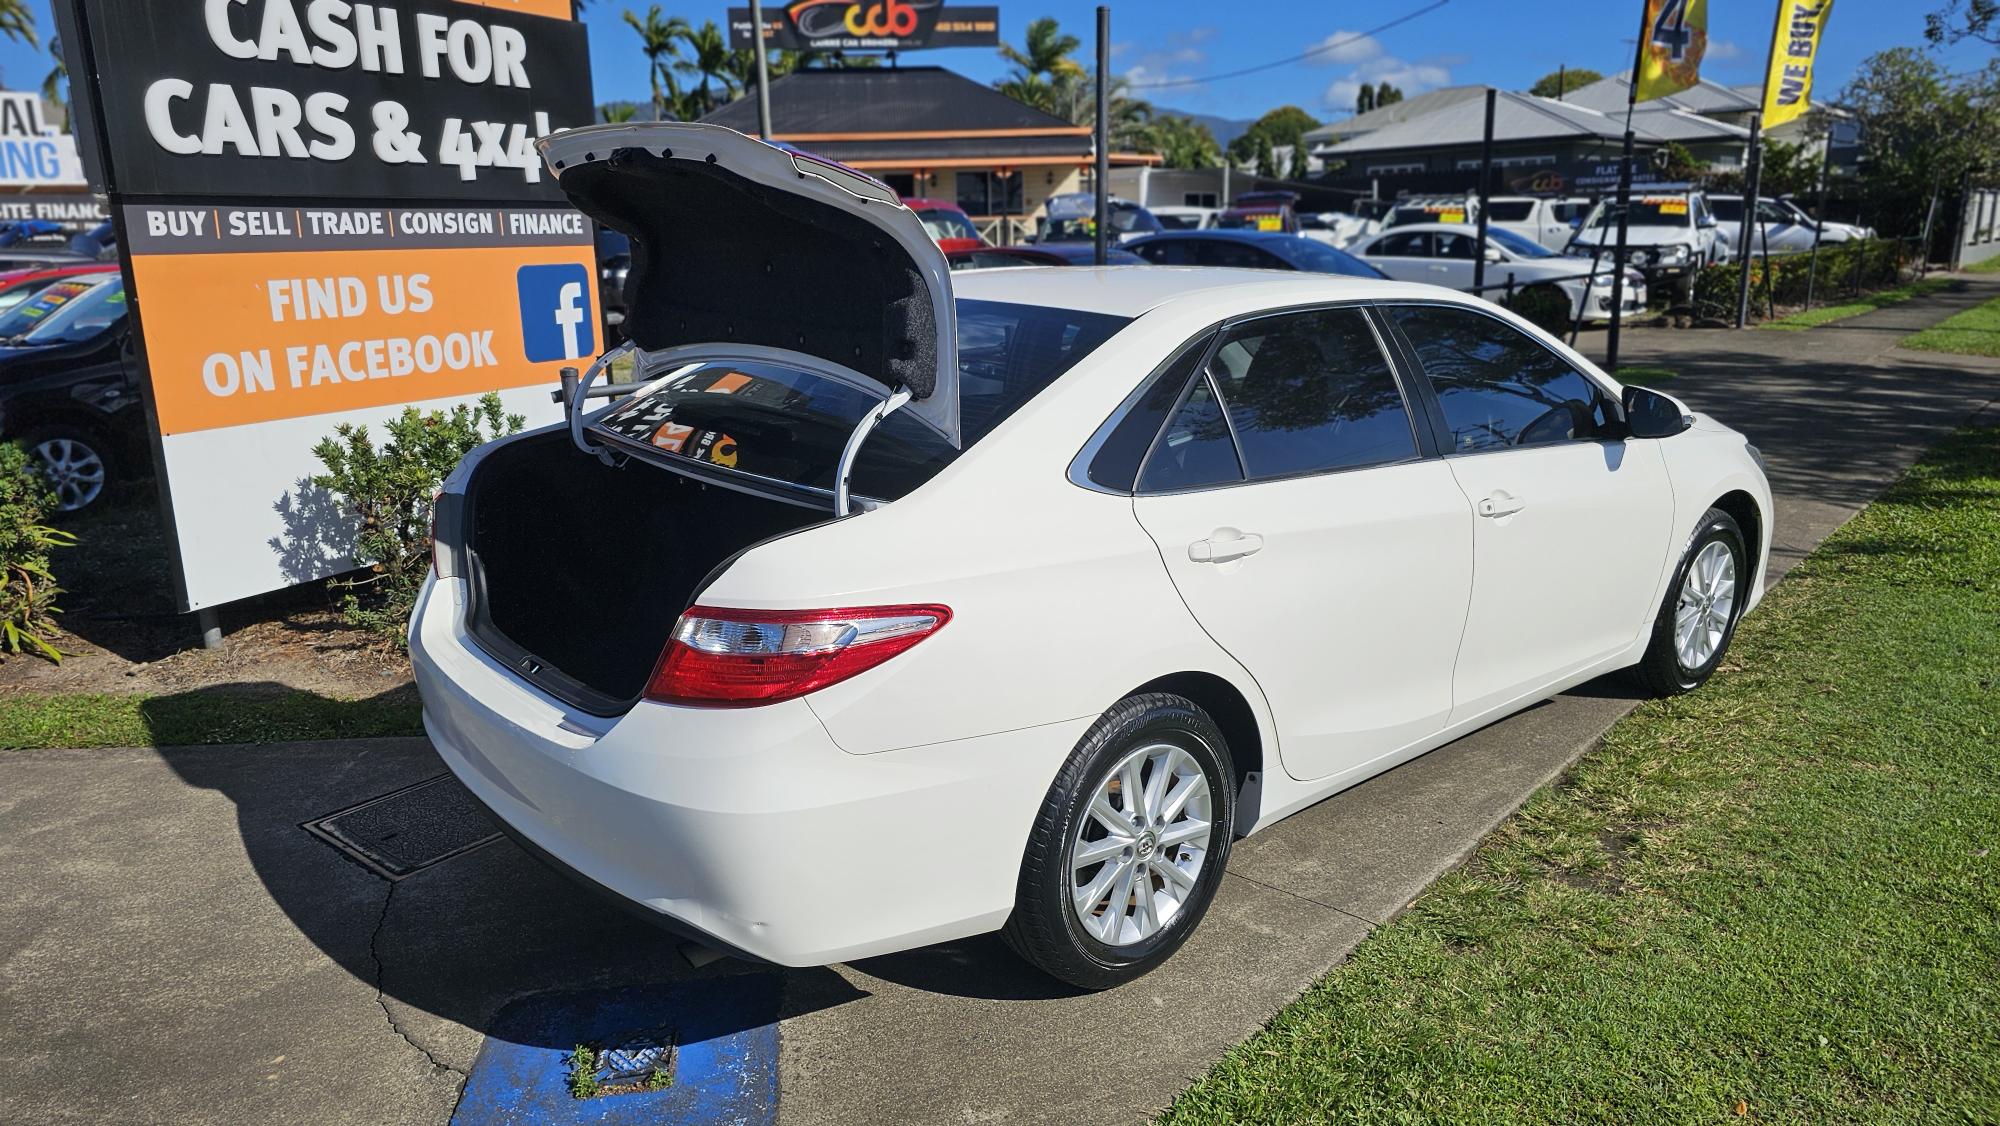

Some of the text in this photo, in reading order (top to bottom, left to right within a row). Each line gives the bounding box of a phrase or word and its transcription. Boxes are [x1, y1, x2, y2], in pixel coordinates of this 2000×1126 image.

[204, 0, 531, 89] CASH FOR
[1776, 64, 1808, 106] WE
[144, 78, 356, 161] CARS
[371, 100, 428, 164] &
[0, 141, 61, 179] ING
[0, 203, 106, 219] ITE FINANC
[146, 210, 584, 236] BUY SELL TRADE CONSIGN FINANCE
[266, 273, 434, 323] FIND US
[202, 329, 499, 397] ON FACEBOOK
